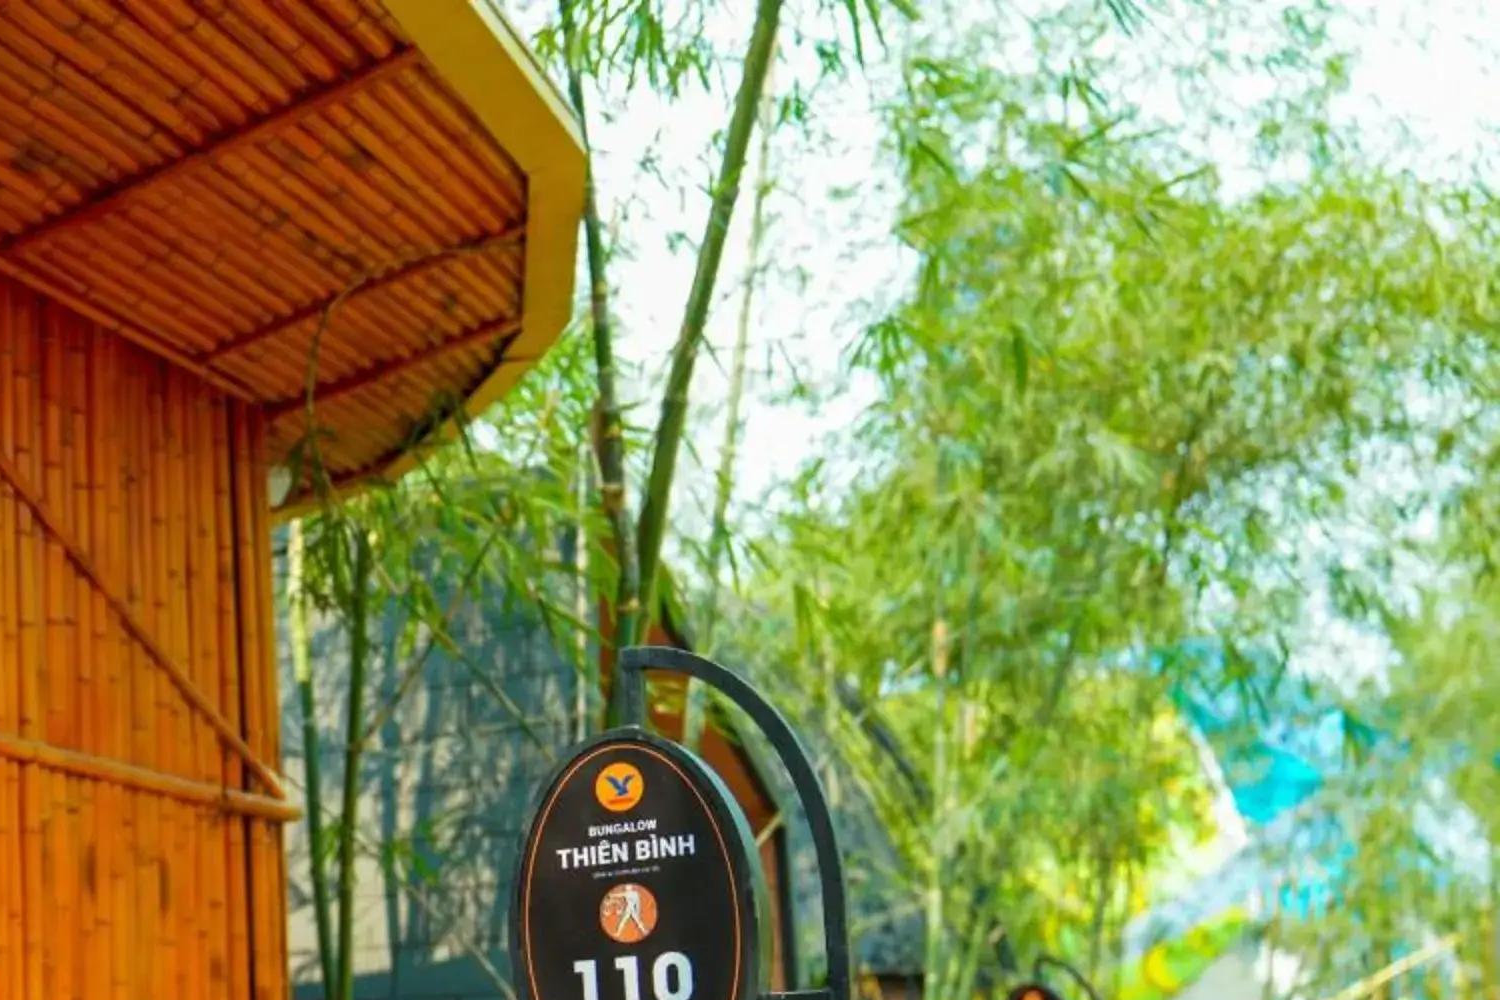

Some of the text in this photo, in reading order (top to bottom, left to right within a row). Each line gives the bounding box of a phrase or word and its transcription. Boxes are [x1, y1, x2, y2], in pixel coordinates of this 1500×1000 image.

[588, 819, 657, 837] BUNGALOW
[556, 834, 695, 869] THIÊN BÌNH
